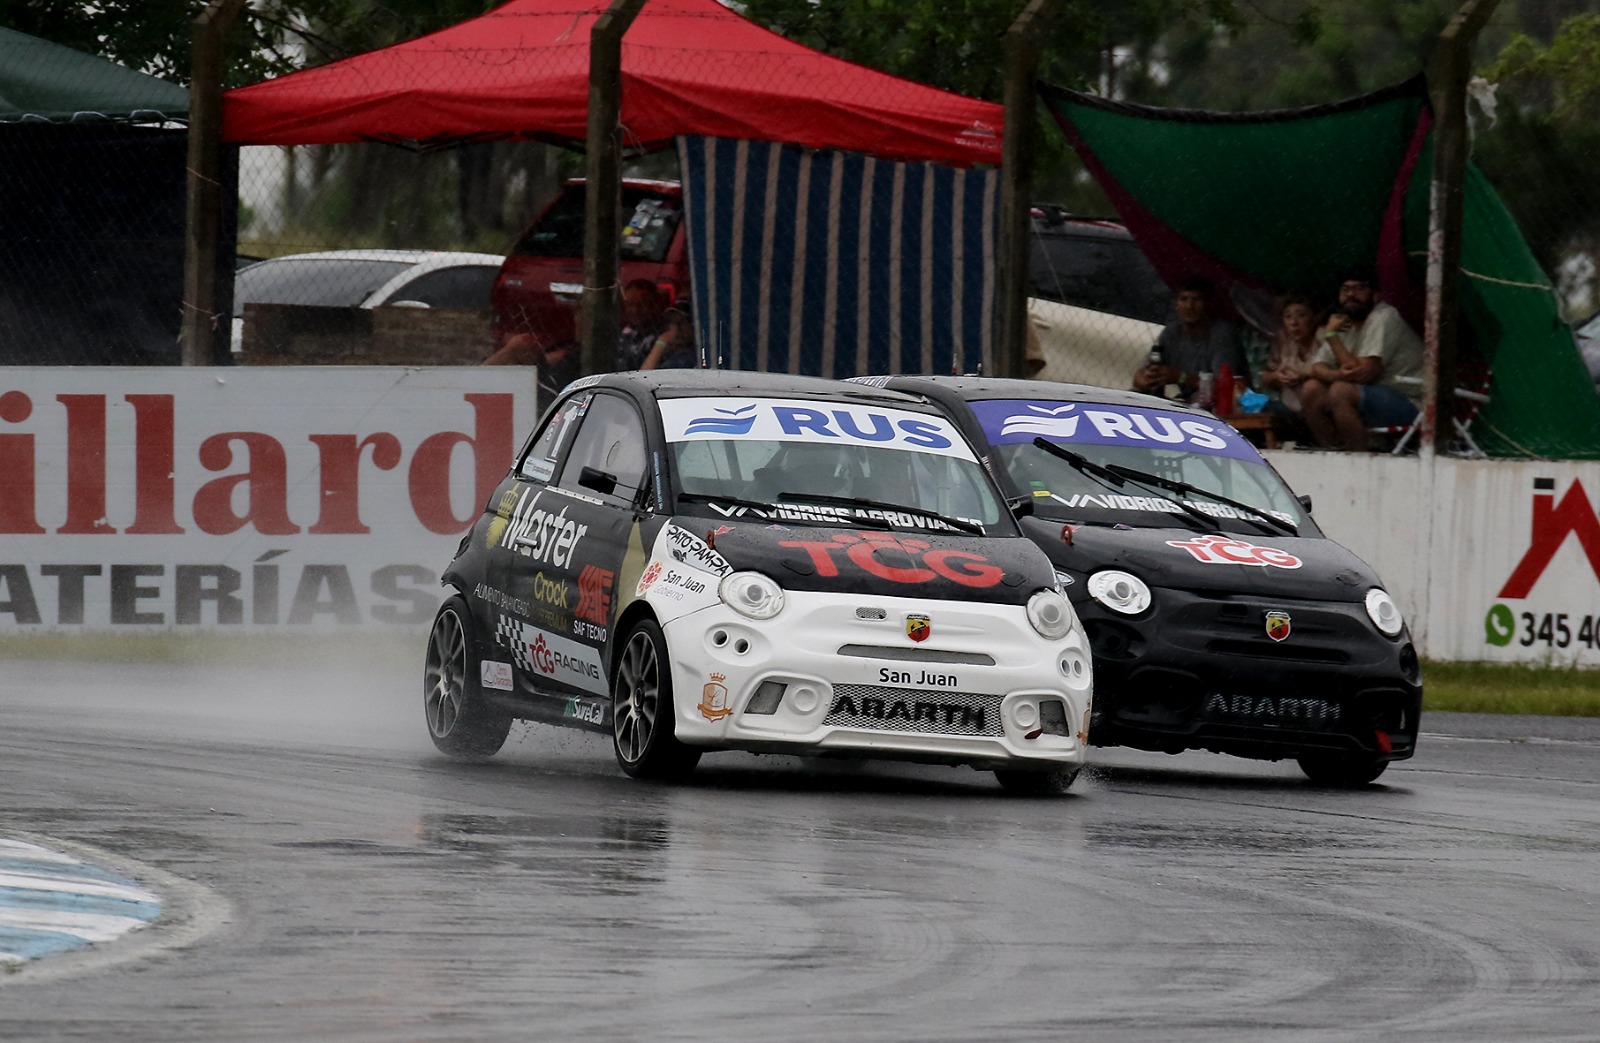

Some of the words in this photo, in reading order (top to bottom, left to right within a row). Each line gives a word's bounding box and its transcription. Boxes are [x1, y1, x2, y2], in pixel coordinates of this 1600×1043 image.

[771, 406, 953, 449] RUS
[1083, 410, 1228, 450] RUS
[767, 503, 853, 524] VIDRIOS
[1099, 494, 1186, 514] VIDRIOS
[501, 486, 588, 570] Master
[666, 525, 694, 548] PATO
[688, 541, 730, 578] PAMPA
[778, 540, 1006, 588] TCG
[1167, 538, 1301, 568] TCG
[0, 549, 440, 626] ATERÍAS
[534, 571, 568, 609] Crock
[663, 569, 682, 586] San
[680, 576, 706, 595] Juan
[573, 619, 586, 636] SAF
[586, 623, 607, 643] TECNO
[1520, 611, 1571, 649] 345
[529, 643, 555, 674] TCG
[554, 651, 600, 680] RACING
[879, 668, 912, 686] San
[916, 669, 958, 688] Juan
[831, 694, 986, 731] ABARTH
[1206, 693, 1342, 720] ABARTH
